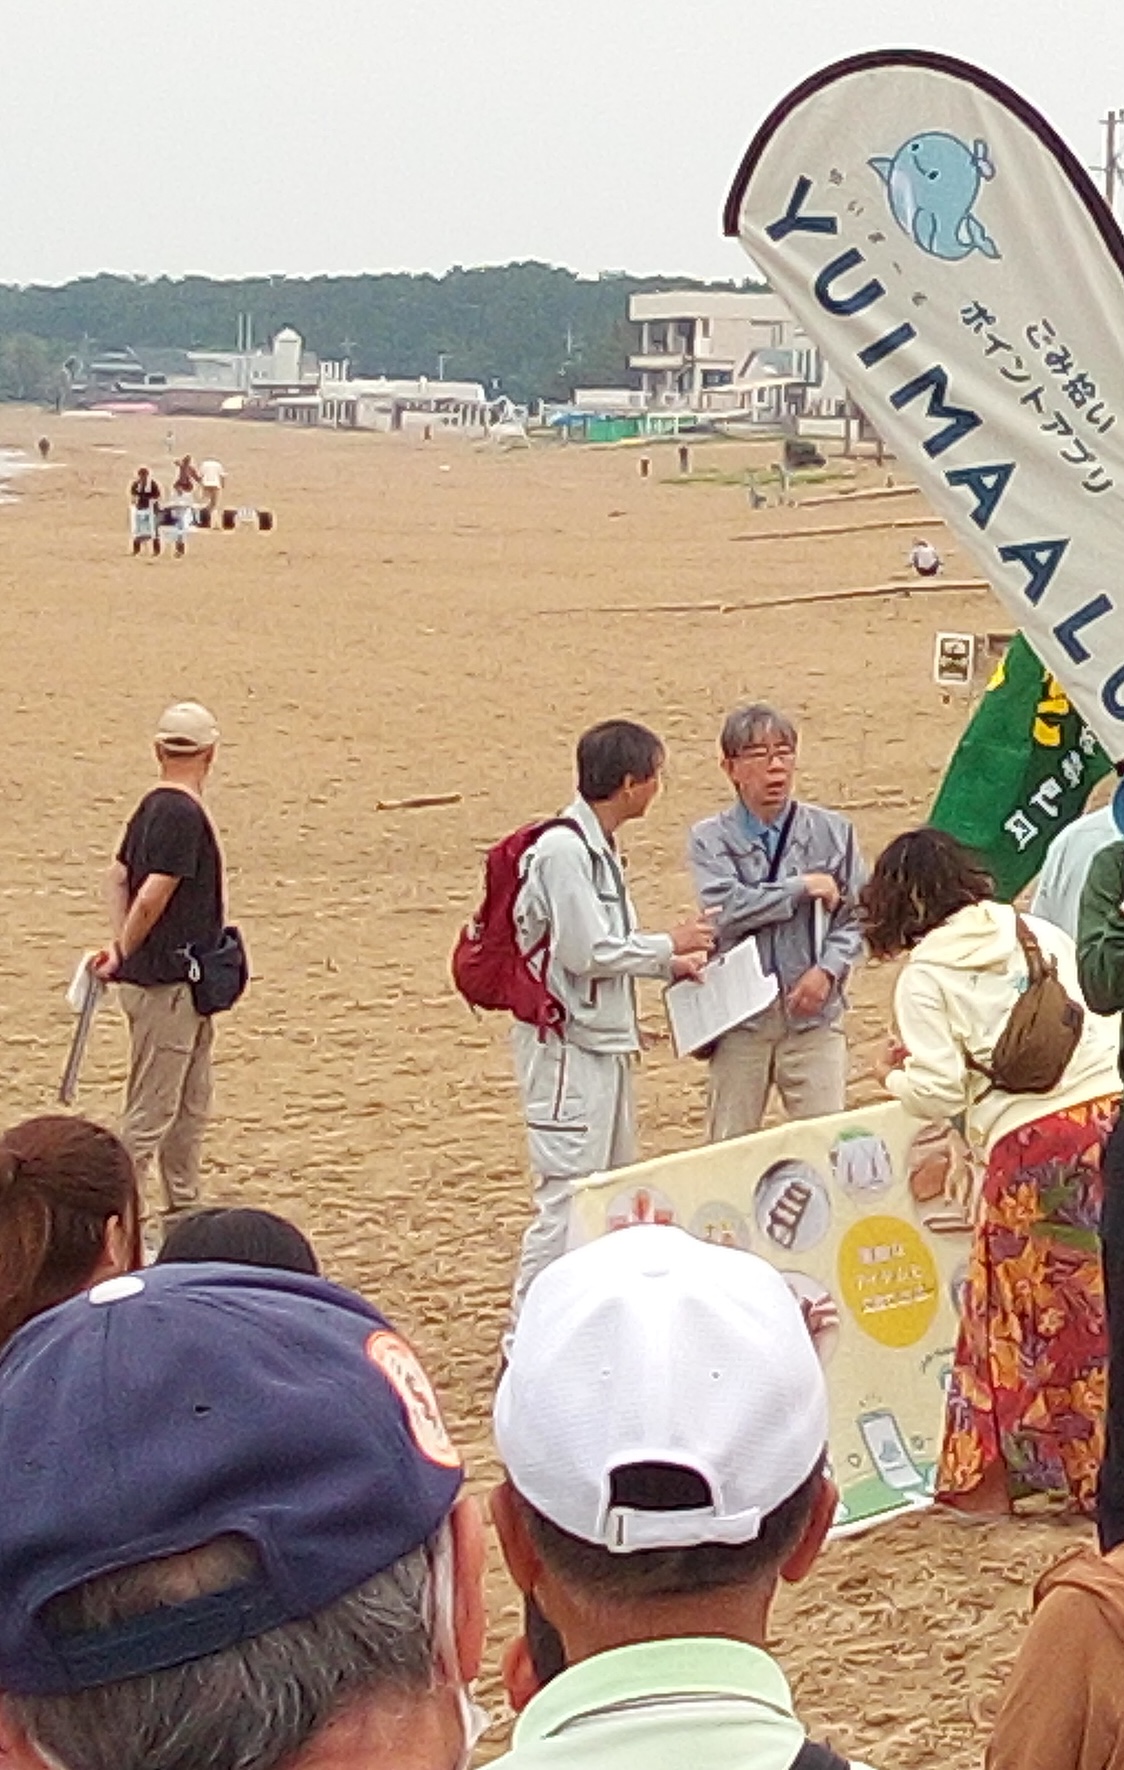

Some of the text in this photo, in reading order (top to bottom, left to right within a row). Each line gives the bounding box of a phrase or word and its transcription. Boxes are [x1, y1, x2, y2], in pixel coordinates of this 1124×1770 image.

[960, 300, 1114, 493] ポイントアプリ
[1025, 317, 1116, 434] ごみ拾い
